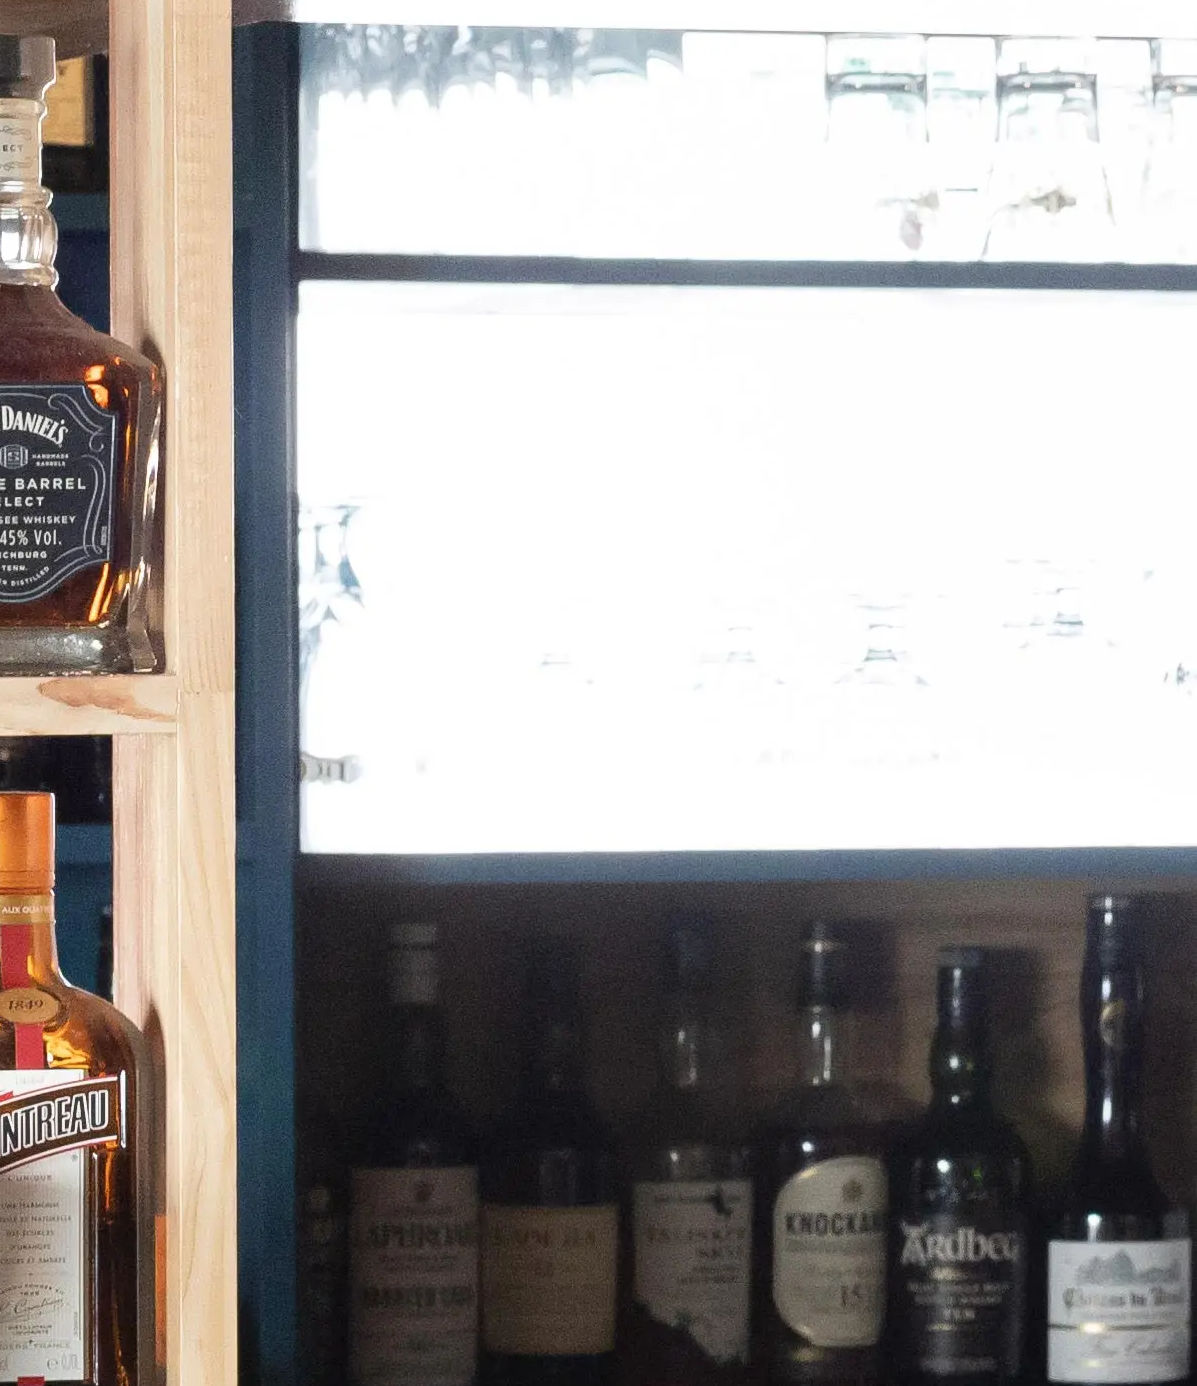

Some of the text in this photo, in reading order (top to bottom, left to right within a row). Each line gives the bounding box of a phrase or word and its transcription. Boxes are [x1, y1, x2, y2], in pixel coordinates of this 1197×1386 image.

[15, 478, 87, 491] BARREL
[23, 515, 77, 525] WHISKEY
[0, 529, 30, 546] 45%
[33, 529, 63, 546] Vol.
[10, 565, 51, 587] DISTILLED
[8, 999, 44, 1011] 1849
